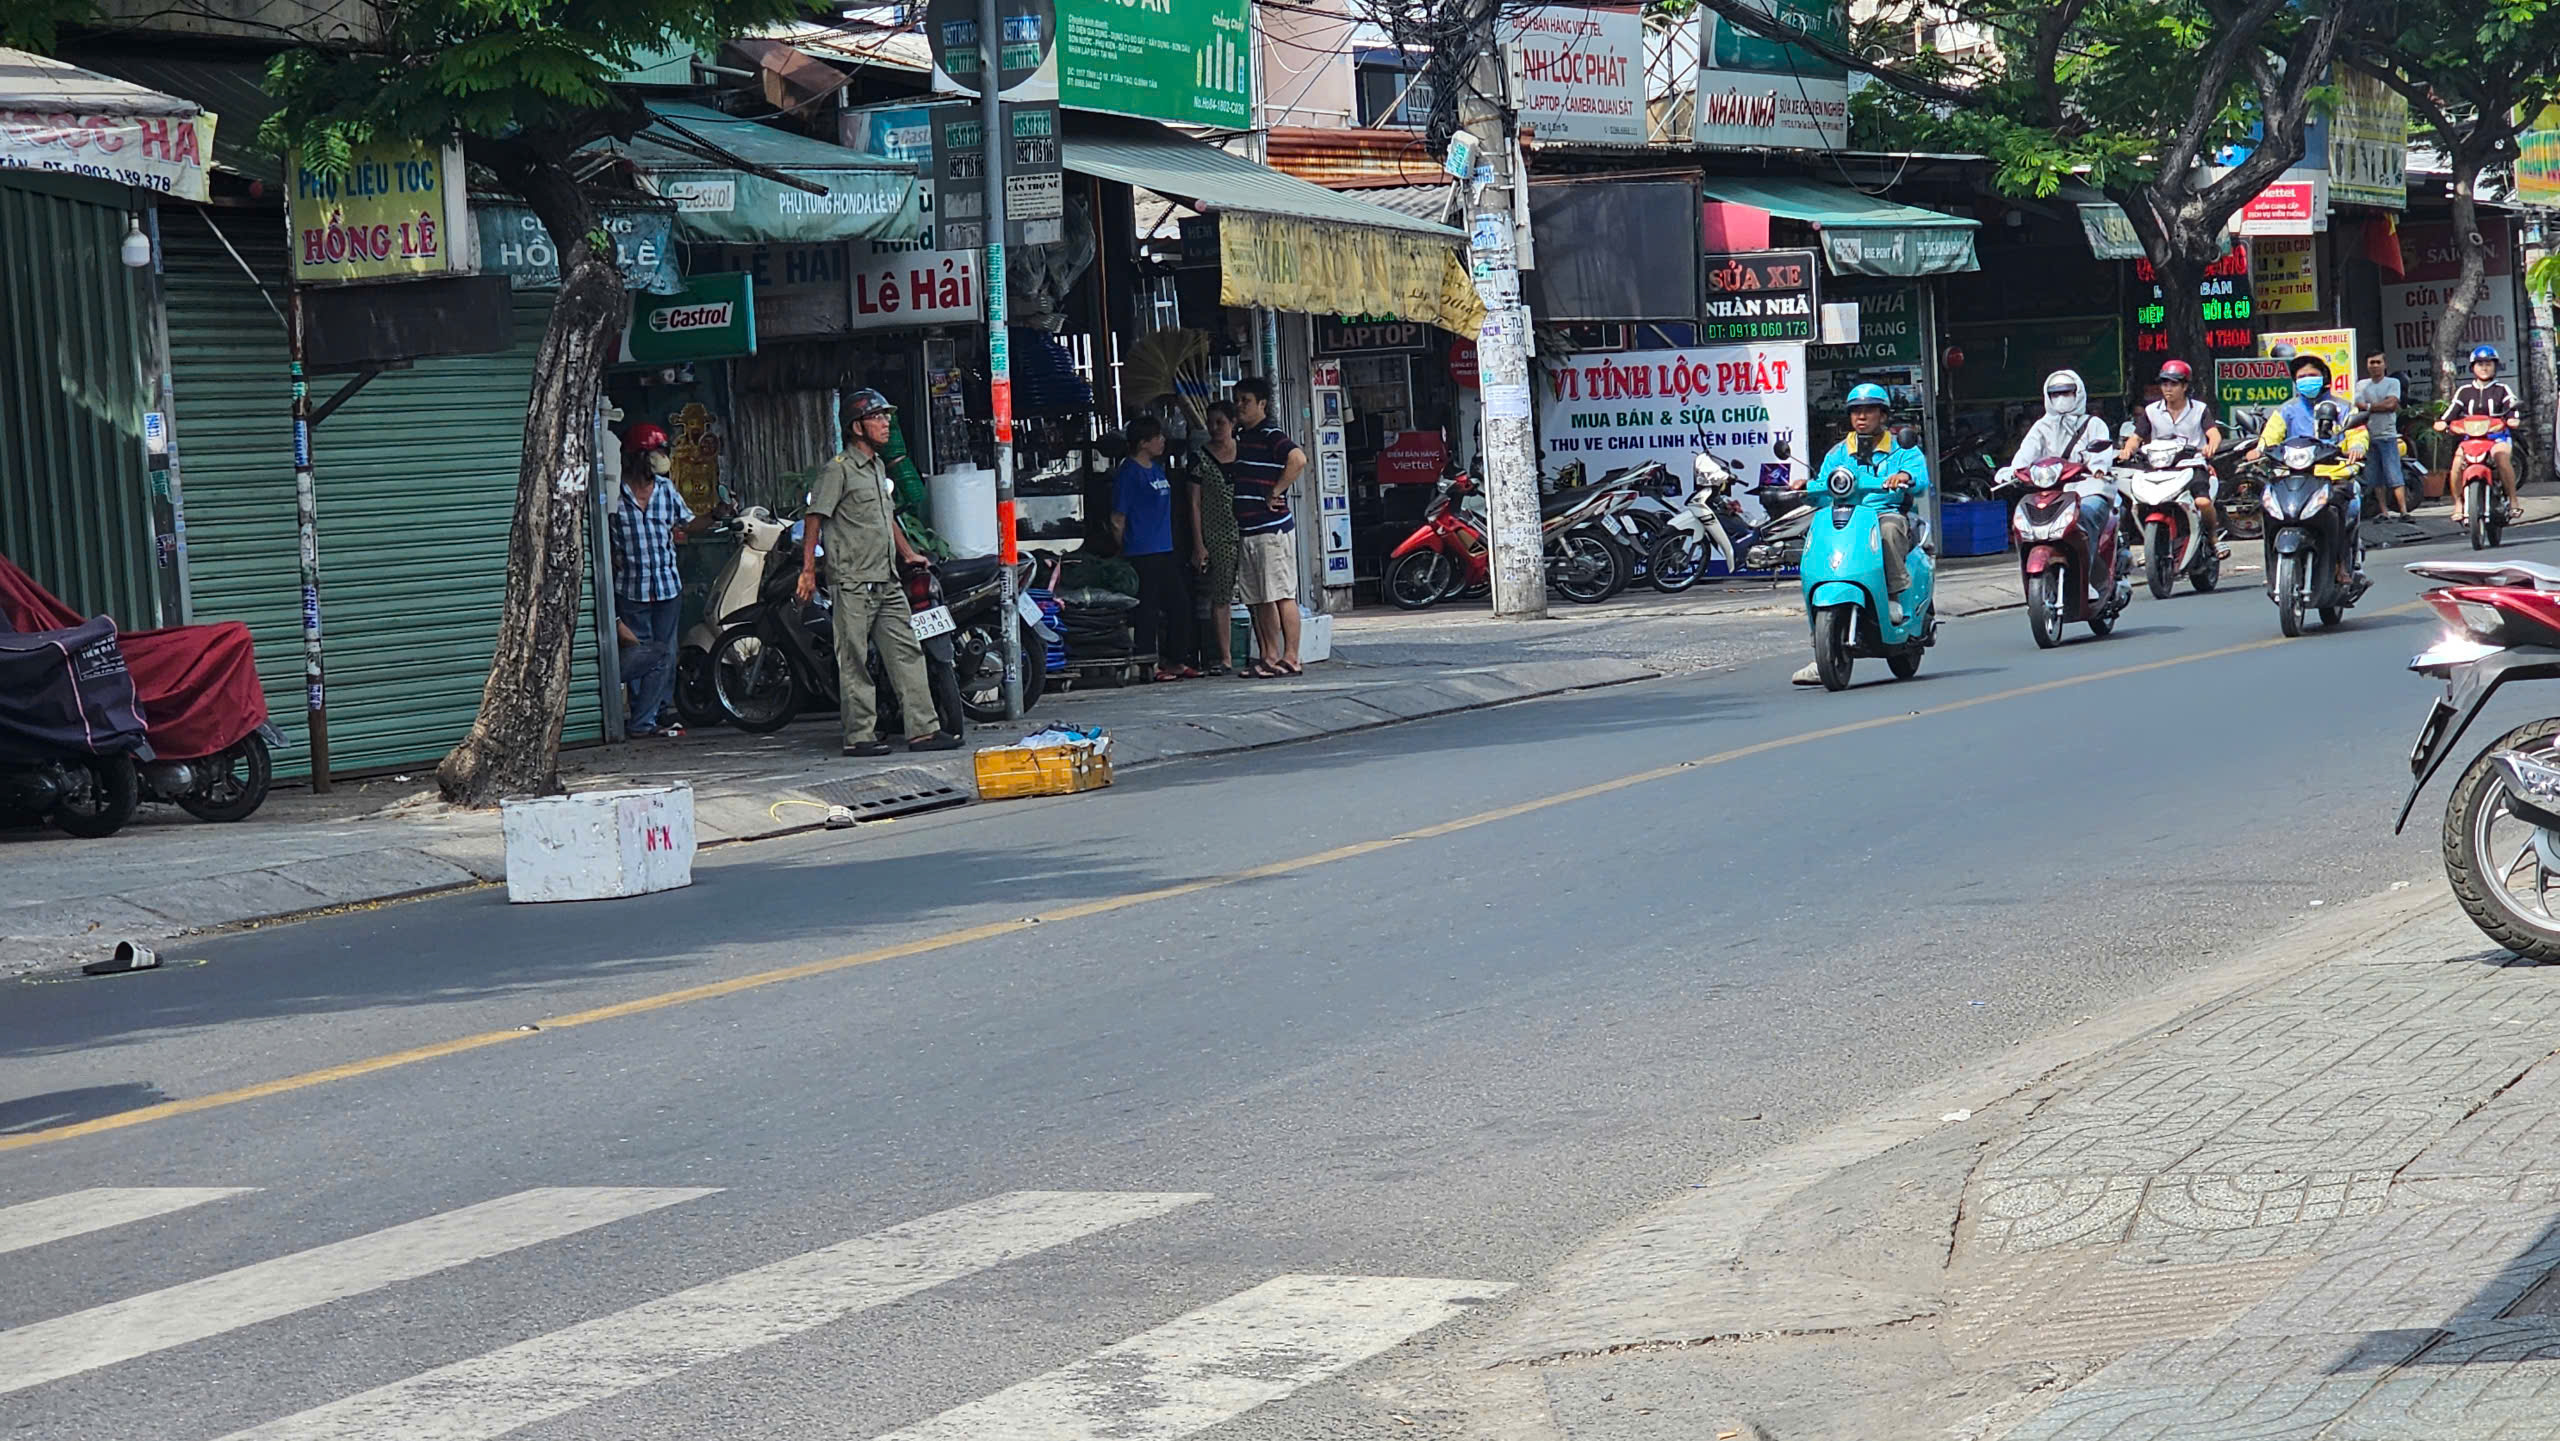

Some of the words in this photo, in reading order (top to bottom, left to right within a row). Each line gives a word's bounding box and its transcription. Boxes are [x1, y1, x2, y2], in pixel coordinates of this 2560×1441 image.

[1551, 41, 1583, 90] LỘC
[1586, 45, 1628, 88] PHÁT
[1529, 95, 1560, 111] LAPTOP
[345, 155, 389, 200] LIỆU
[779, 191, 801, 220] PHỤ
[833, 192, 871, 213] HONDA
[872, 188, 888, 213] LÊ
[303, 208, 391, 264] HỒNG
[400, 211, 437, 258] LÊ
[857, 271, 900, 314] Lê
[910, 258, 971, 310] Hải
[1708, 260, 1761, 291] SỬA
[1766, 265, 1802, 288] XE
[2200, 278, 2233, 296] BÁN
[1706, 296, 1761, 317] NHÀN
[1765, 294, 1810, 315] NHÃ
[2405, 284, 2438, 307] CỬA
[669, 307, 728, 329] Castrol
[1728, 323, 1758, 337] 0918
[1760, 322, 1783, 337] 060
[1786, 321, 1808, 335] 173
[1327, 324, 1416, 348] LAPTOP
[1848, 342, 1872, 358] TAY
[1876, 343, 1897, 356] GA
[1584, 357, 1652, 399] TÍNH
[1657, 354, 1712, 405] LỘC
[1717, 352, 1790, 394] PHÁT
[2220, 361, 2291, 379] HONDA
[2223, 384, 2242, 401] ÚT
[2246, 385, 2289, 401] SANG
[1571, 412, 1611, 428] MUA
[1616, 409, 1653, 427] BÁN
[1660, 410, 1673, 425] &
[1679, 405, 1716, 425] SỬA
[1721, 405, 1770, 423] CHỮA
[1550, 438, 1579, 451] THU
[1583, 438, 1602, 450] VE
[1607, 436, 1644, 449] CHAI
[1650, 434, 1685, 448] LINH
[1689, 432, 1727, 449] KIỆN
[1731, 430, 1769, 447] ĐIỆN
[1393, 461, 1434, 470] viettel
